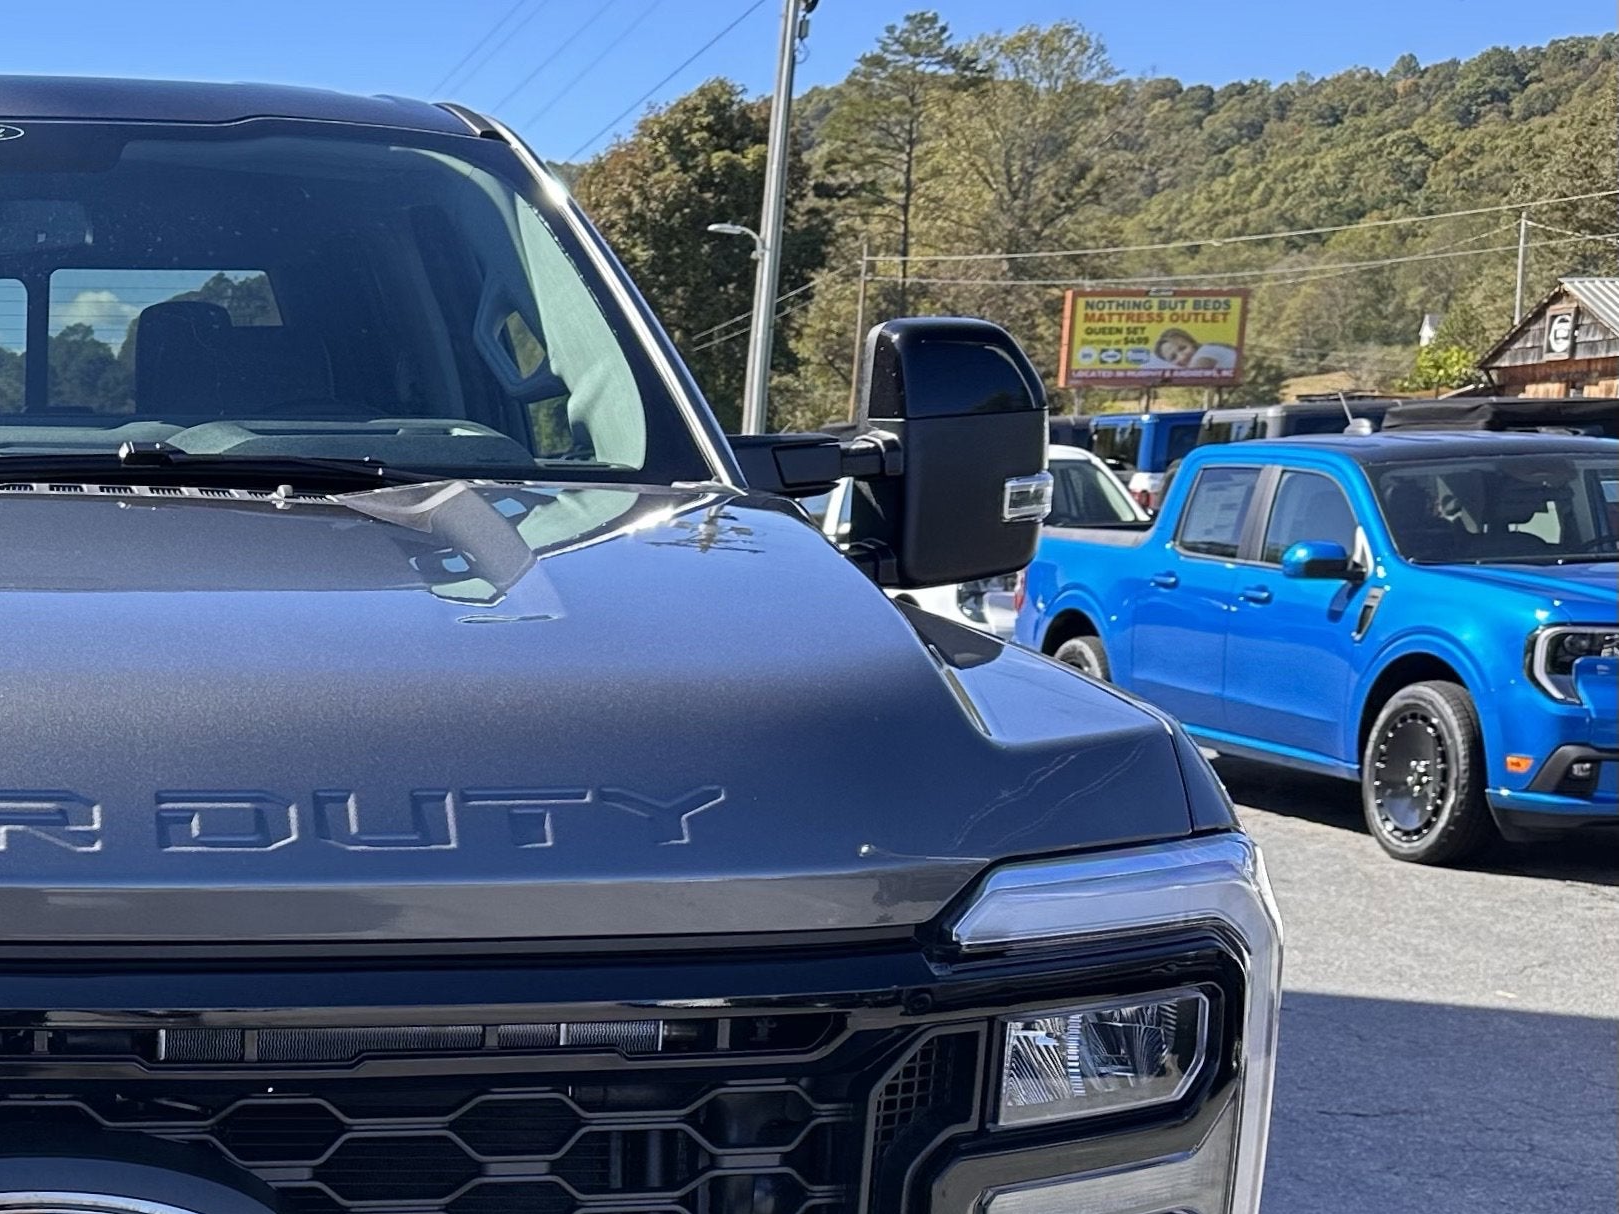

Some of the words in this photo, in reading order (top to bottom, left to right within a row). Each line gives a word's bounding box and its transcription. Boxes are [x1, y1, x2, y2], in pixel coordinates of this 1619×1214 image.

[1085, 300, 1153, 311] NOTHING
[1157, 300, 1187, 310] BUT
[1193, 299, 1231, 311] BEDS
[1084, 312, 1165, 324] MATTRESS
[1169, 312, 1230, 323] OUTLET
[1085, 326, 1123, 335] QUEEN
[1126, 326, 1146, 335] SET
[155, 787, 726, 852] DUTY
